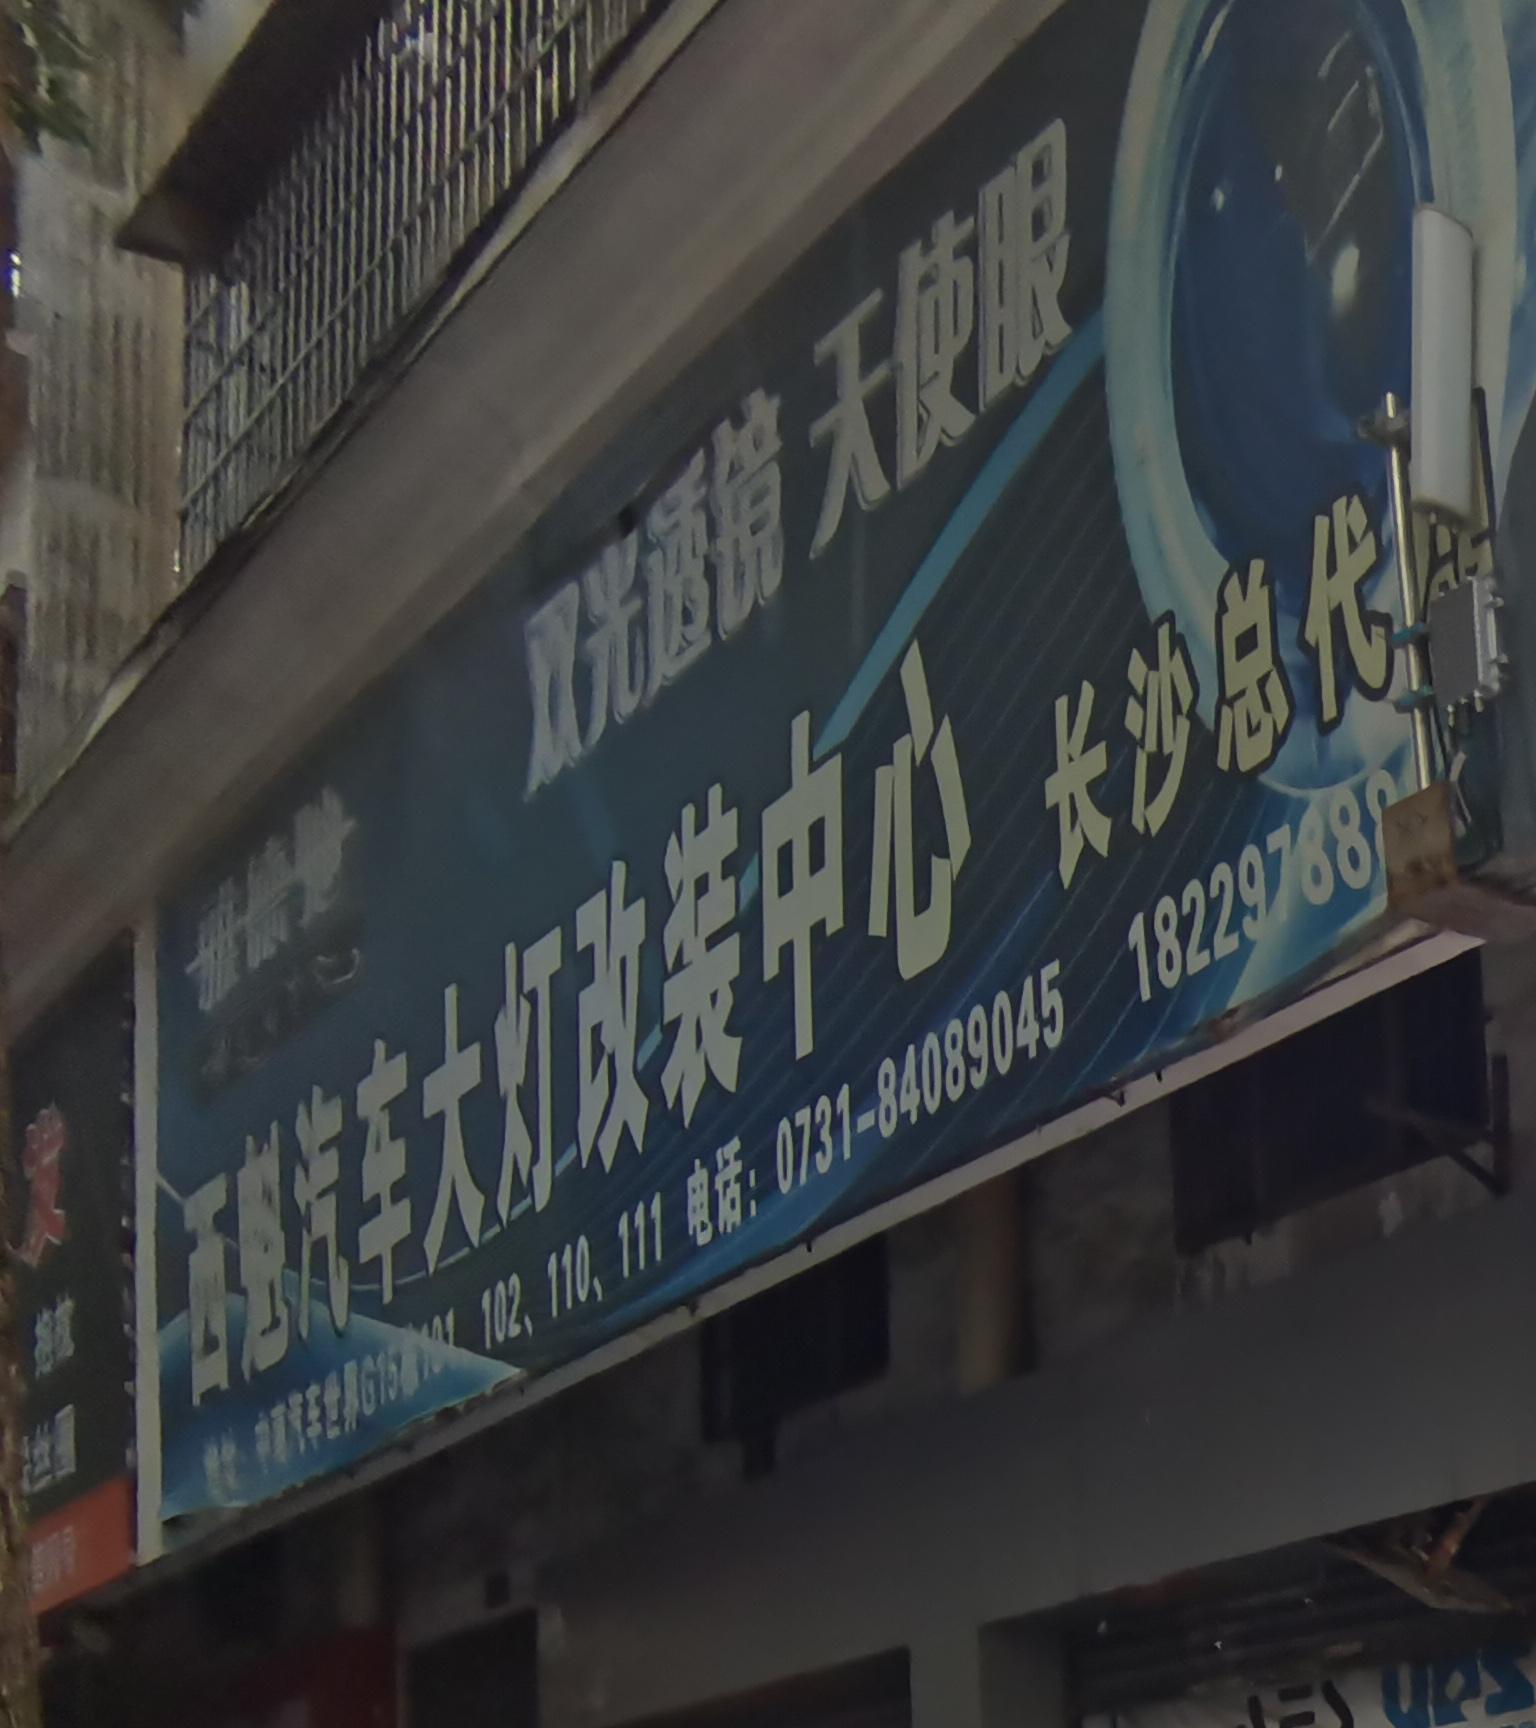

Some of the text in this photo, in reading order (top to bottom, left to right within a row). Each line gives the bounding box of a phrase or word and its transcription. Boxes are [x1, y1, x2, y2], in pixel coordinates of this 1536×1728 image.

[524, 117, 1072, 802] 双光透镜 天使眼
[777, 959, 1065, 1196] 0731-84089045
